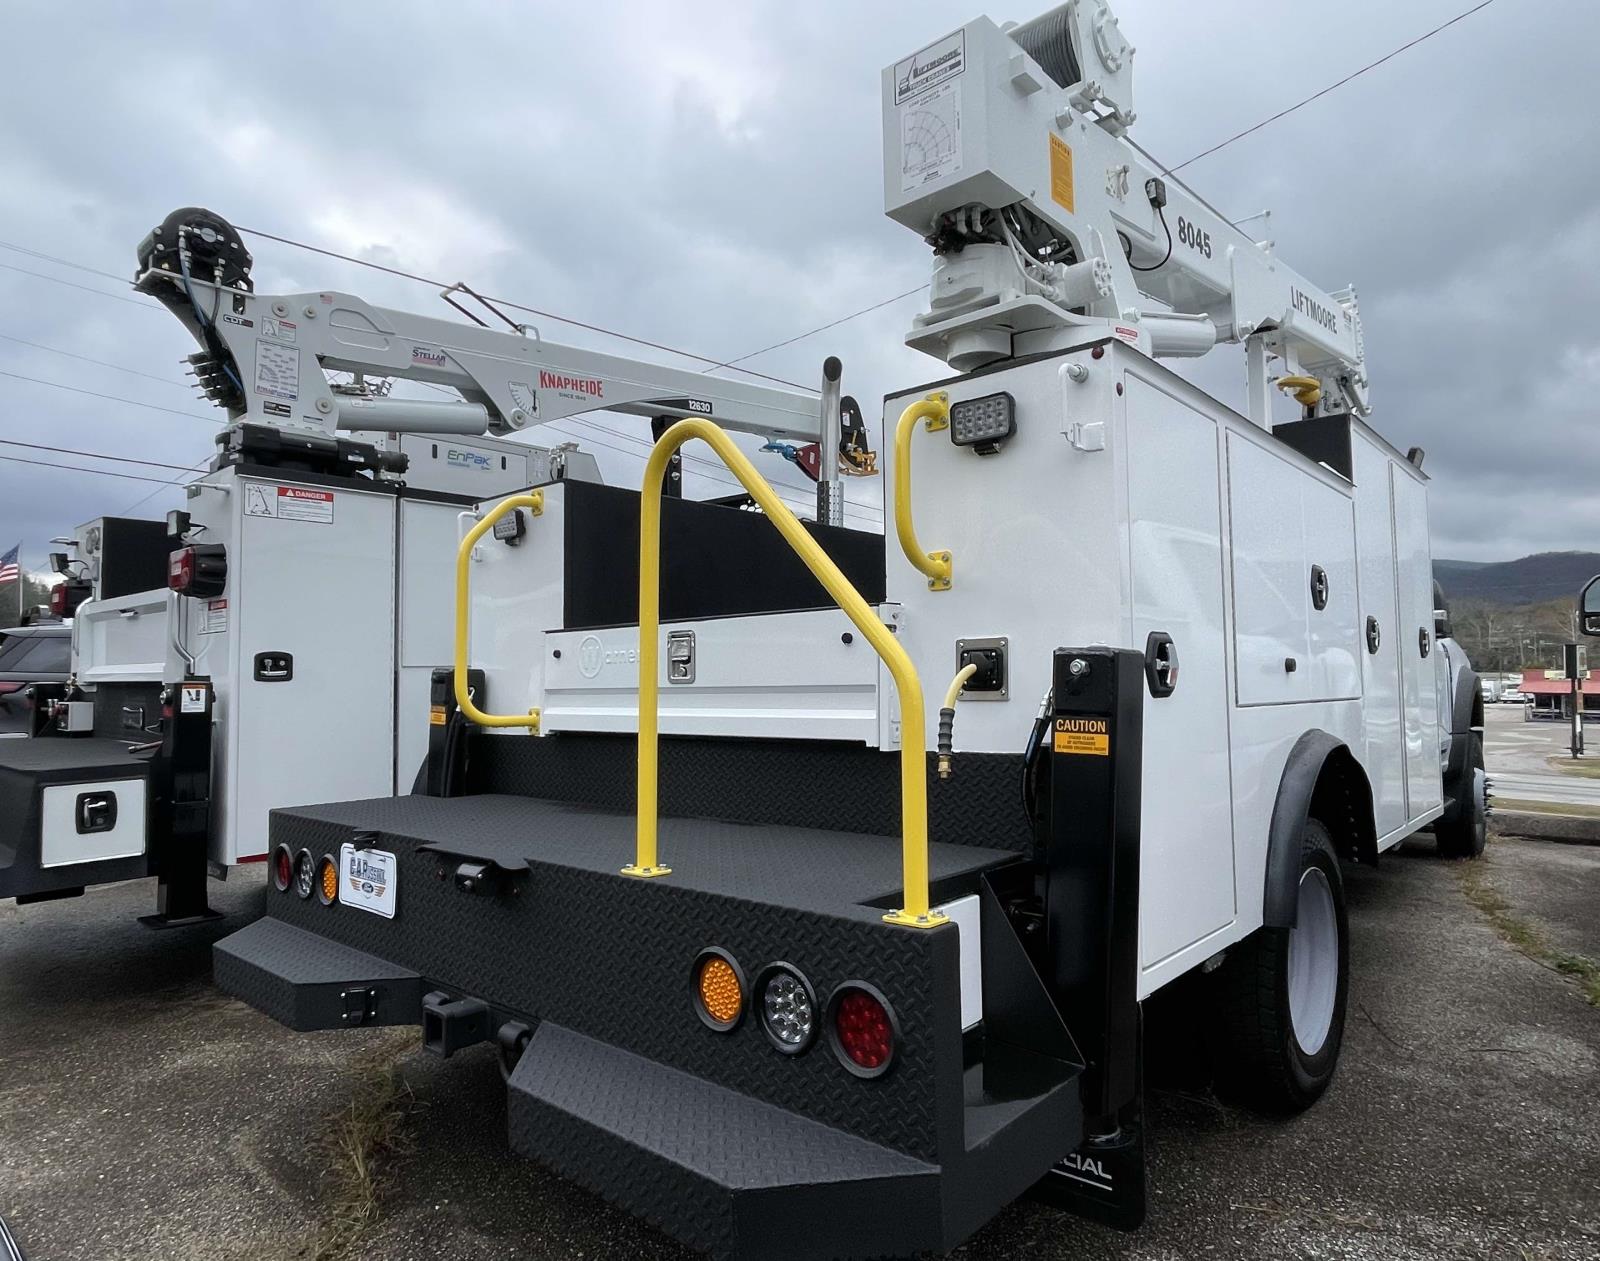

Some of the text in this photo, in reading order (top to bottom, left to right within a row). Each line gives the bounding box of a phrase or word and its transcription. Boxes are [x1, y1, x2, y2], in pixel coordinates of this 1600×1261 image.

[1178, 216, 1211, 259] 8045
[1290, 286, 1337, 334] LIFTMOORE
[412, 349, 446, 362] STELLAR
[539, 370, 604, 398] KNAPHEIDE
[688, 400, 710, 412] 12630
[447, 450, 490, 466] EnPak
[295, 491, 326, 500] DANGER
[1056, 719, 1106, 733] CAUTION
